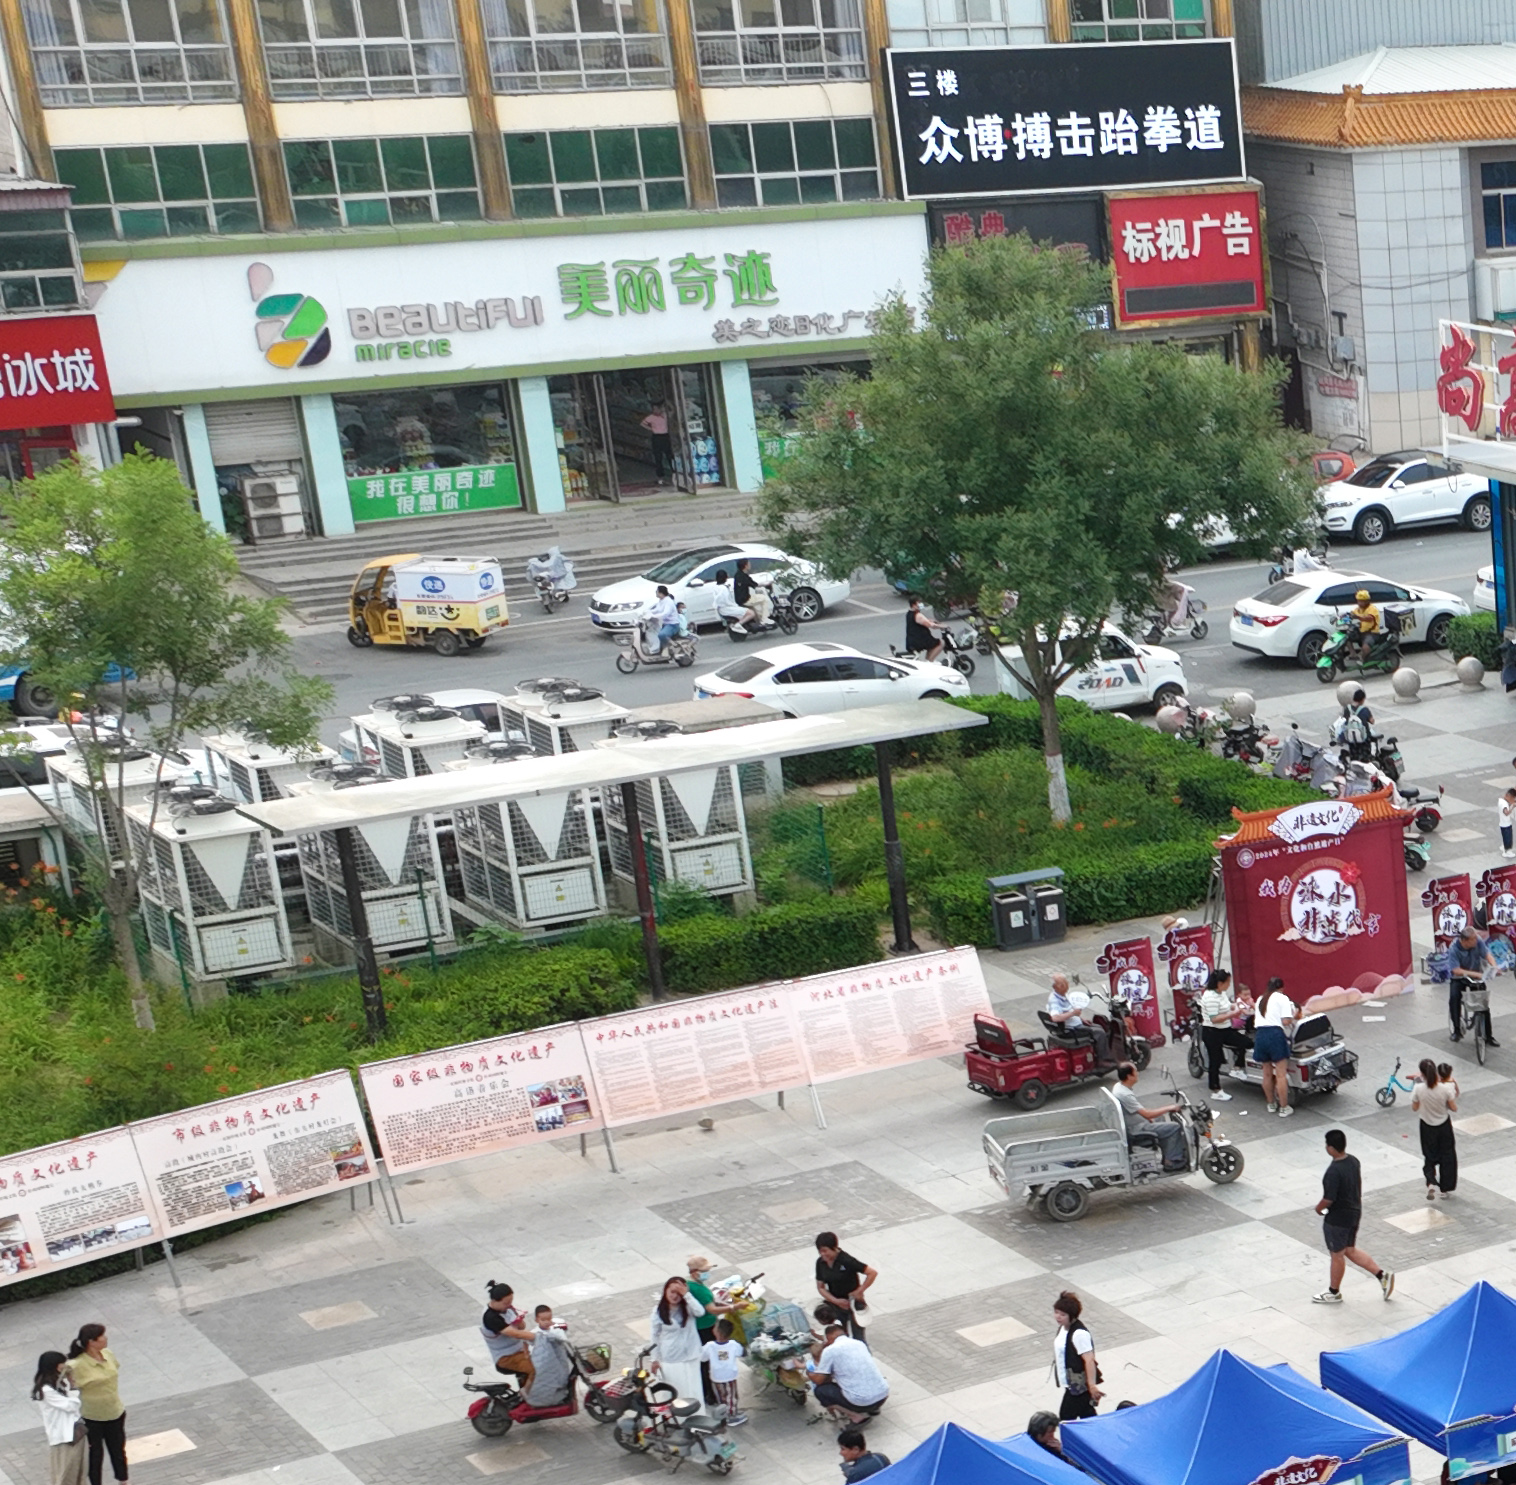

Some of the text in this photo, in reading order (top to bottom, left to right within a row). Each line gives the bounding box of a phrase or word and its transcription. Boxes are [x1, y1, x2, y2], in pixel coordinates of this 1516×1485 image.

[907, 68, 959, 98] 三楼
[1121, 210, 1254, 264] 标视广告
[557, 249, 780, 320] 美丽奇迹
[0, 347, 100, 398] 冰城
[1292, 810, 1340, 832] 非遗文化
[1297, 875, 1351, 906] 涞水
[391, 1041, 557, 1089] 国家级非物质文化遗产
[171, 1092, 321, 1144] 市级非物质文化遗产
